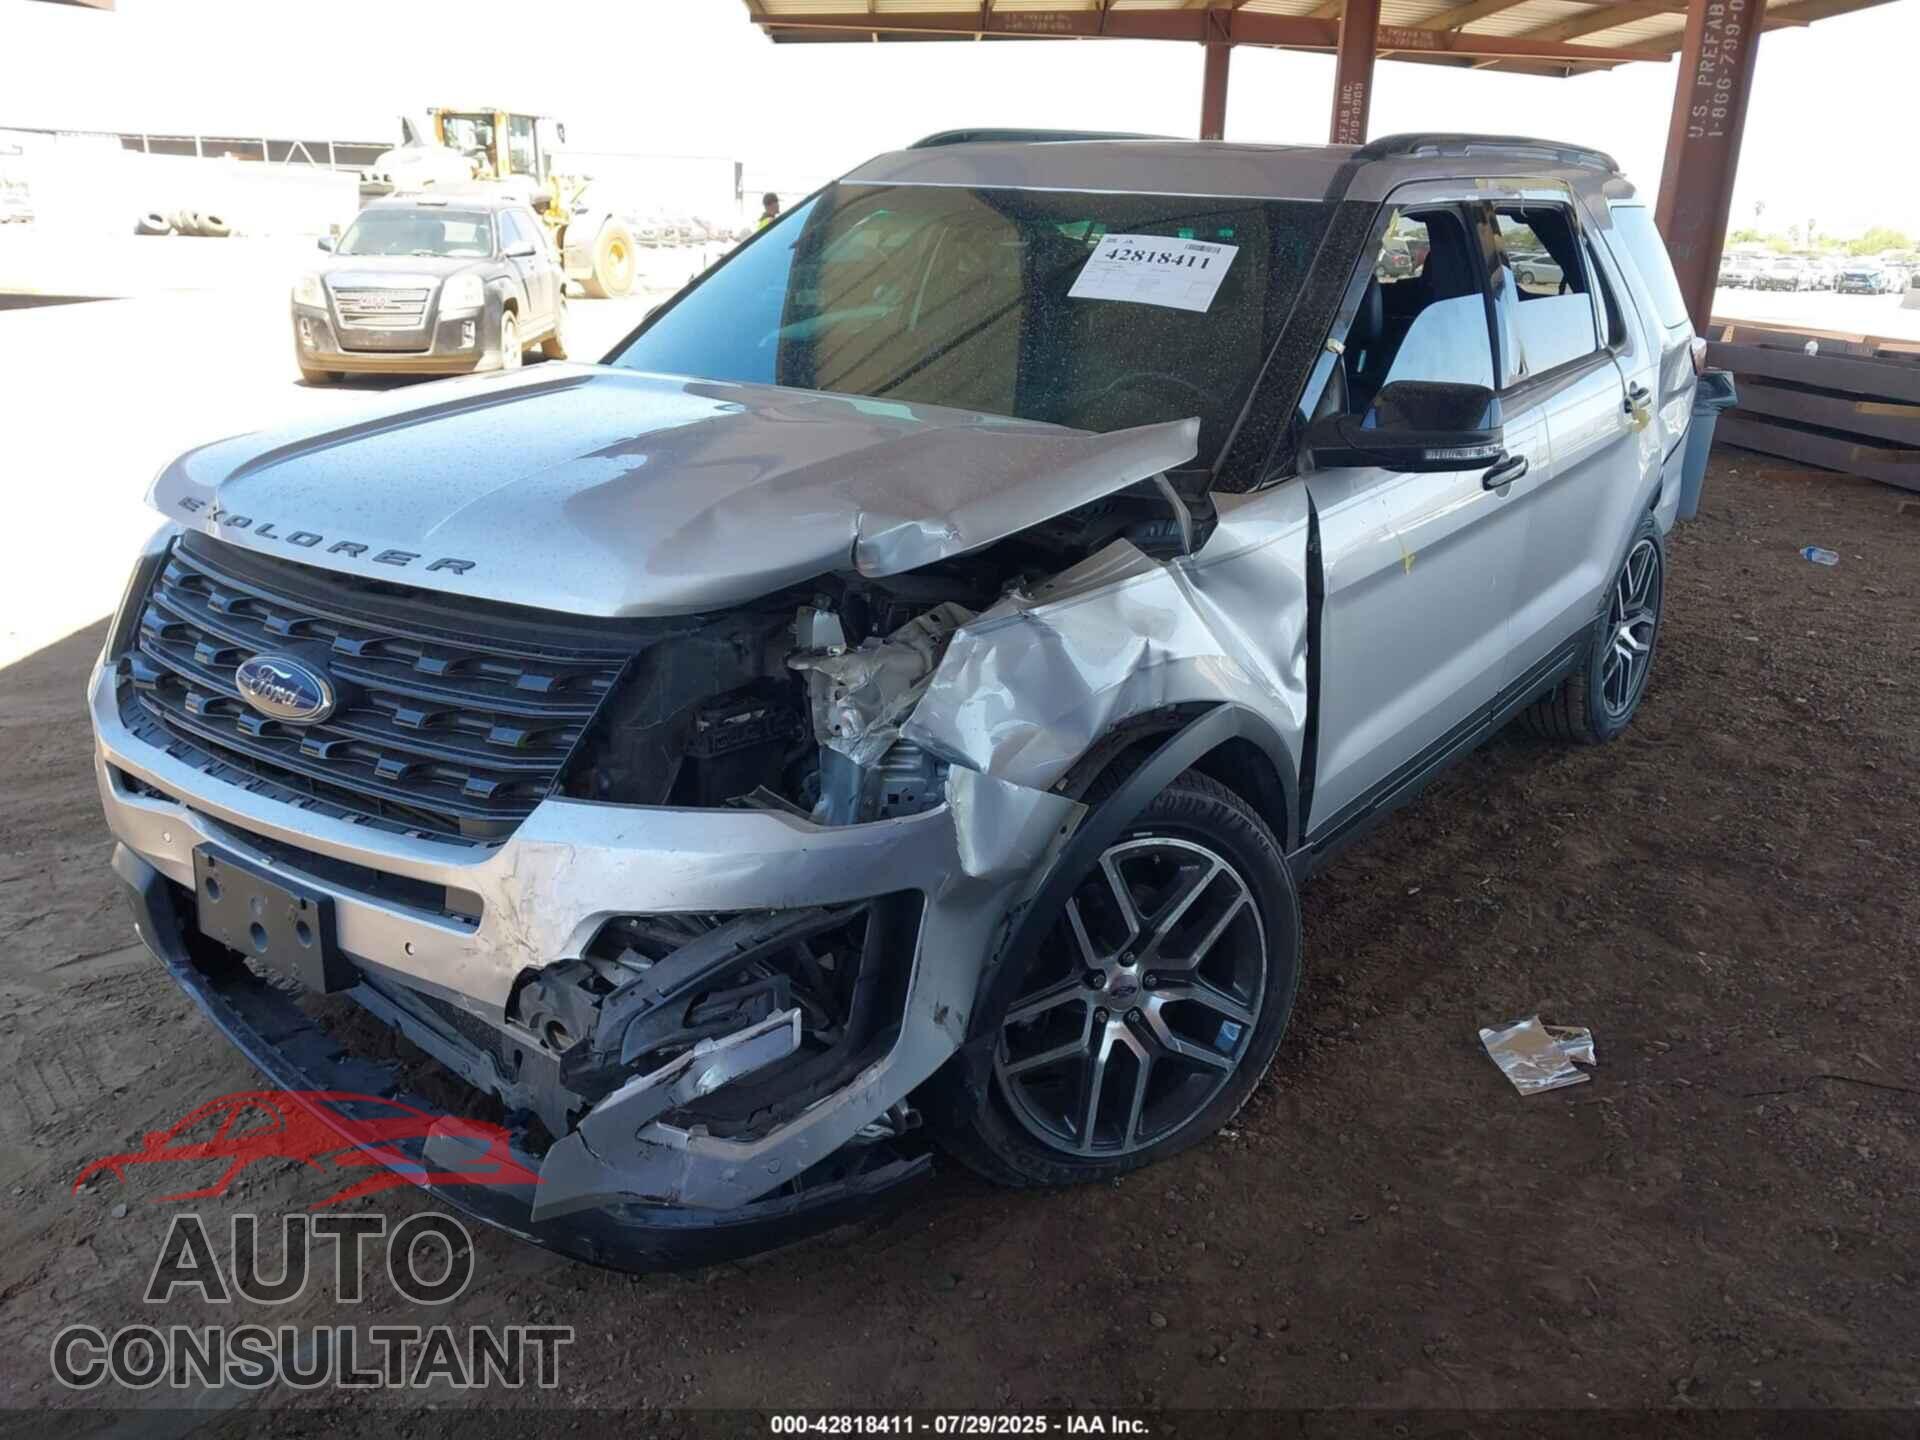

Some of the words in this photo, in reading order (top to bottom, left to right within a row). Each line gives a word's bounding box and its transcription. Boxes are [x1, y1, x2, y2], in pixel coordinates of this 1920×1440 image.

[1697, 3, 1725, 86] PREFAB
[1105, 247, 1210, 269] 42818411
[178, 496, 476, 575] EXPLORER
[249, 664, 304, 708] Ford
